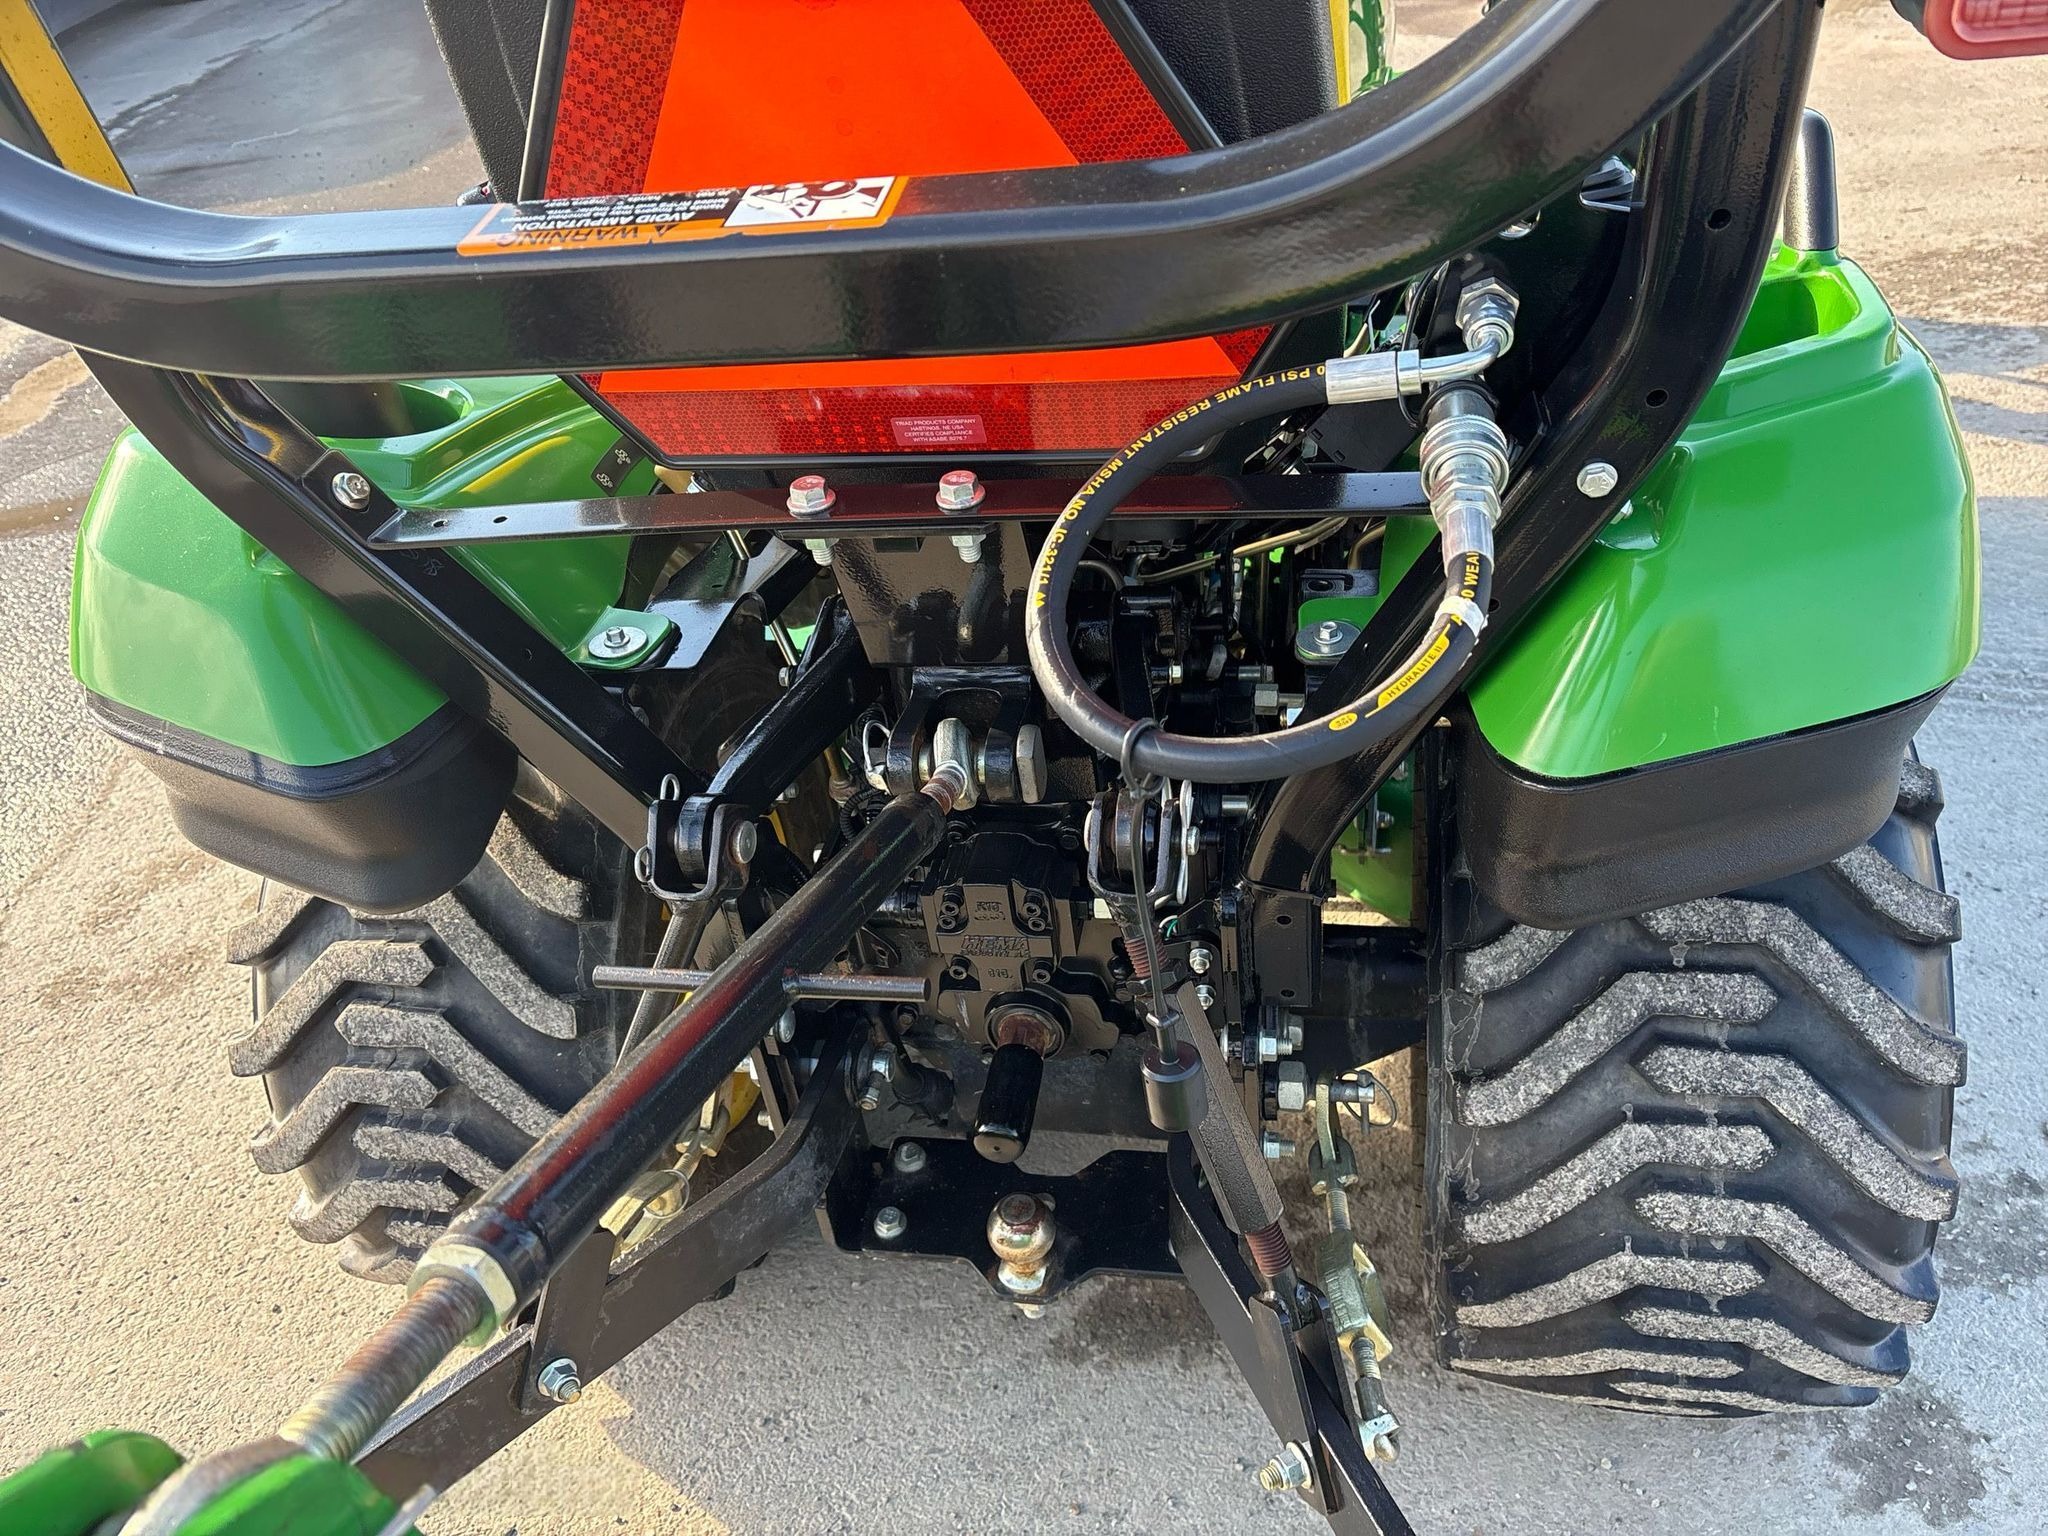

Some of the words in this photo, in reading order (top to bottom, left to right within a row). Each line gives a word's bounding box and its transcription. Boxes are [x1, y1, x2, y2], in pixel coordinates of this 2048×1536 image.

[512, 216, 631, 233] AMPUTATION
[631, 210, 695, 227] AVOID
[496, 225, 638, 248] WARNING
[1214, 373, 1275, 403] FLAME
[1281, 367, 1312, 382] PSI
[1124, 400, 1212, 460] RESISTANT
[1081, 458, 1123, 496] MSHA
[1060, 497, 1086, 524] NO.
[1387, 652, 1437, 698] HYDRALITE
